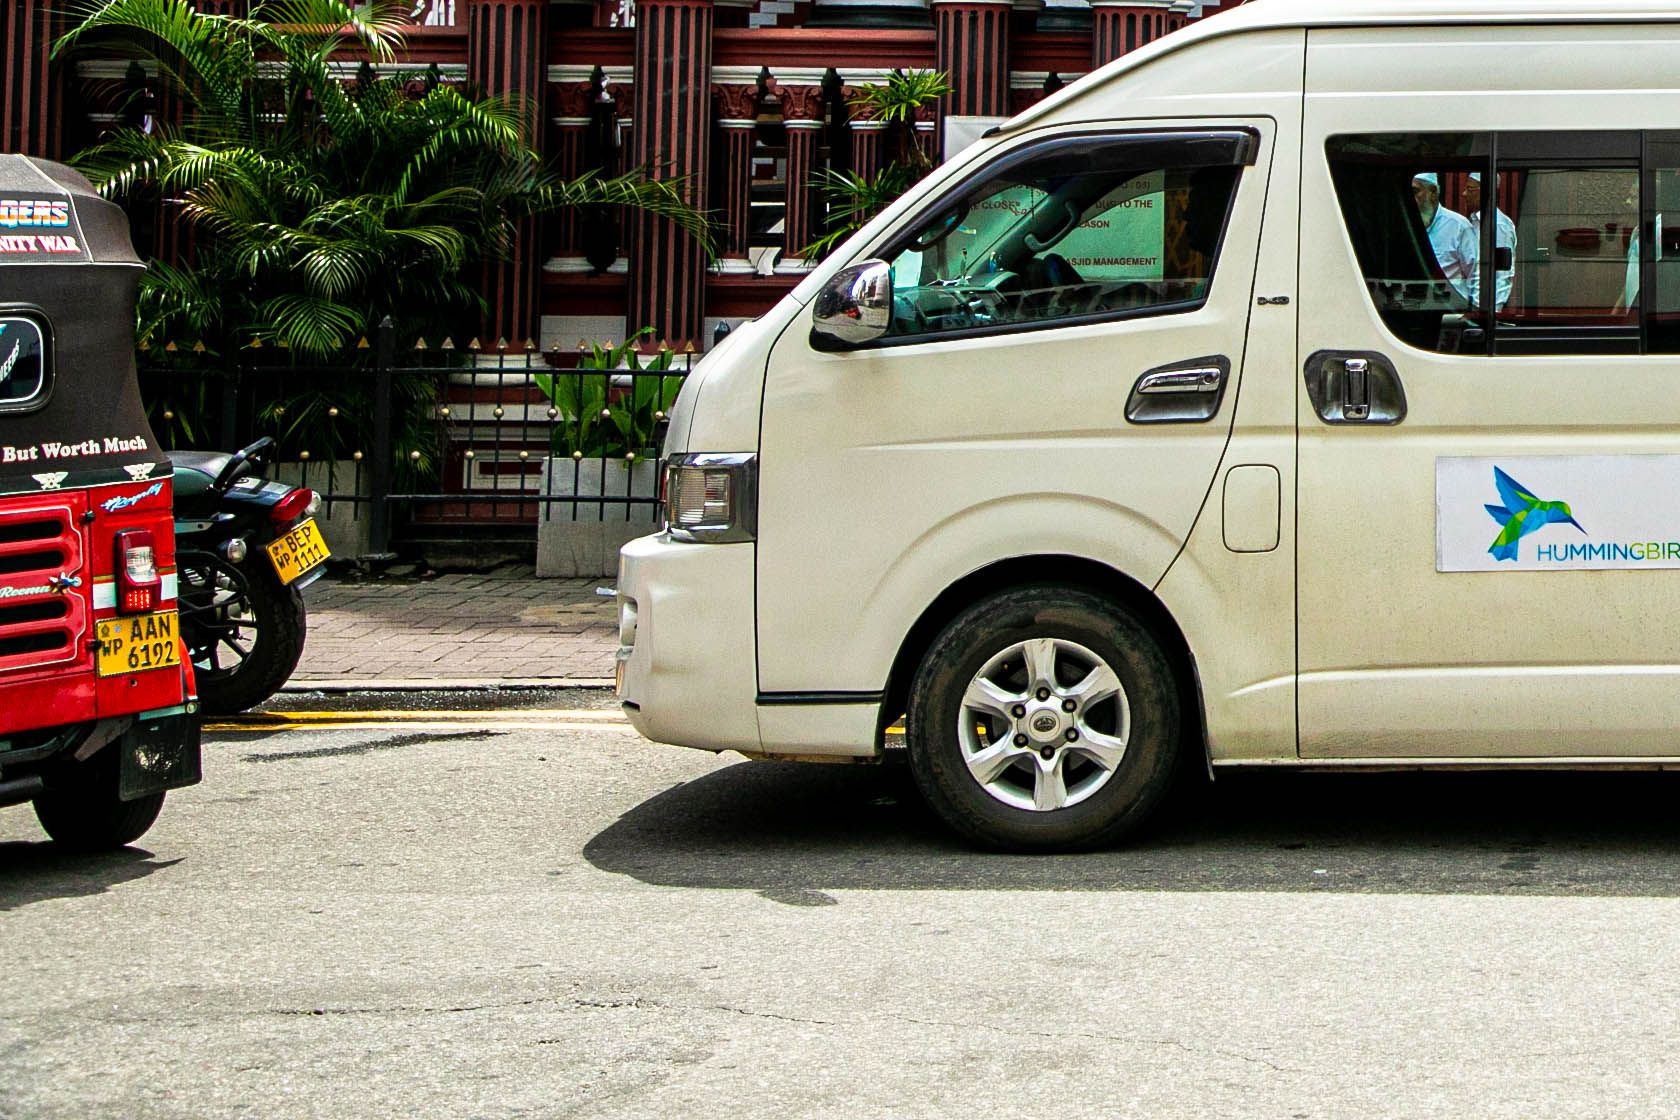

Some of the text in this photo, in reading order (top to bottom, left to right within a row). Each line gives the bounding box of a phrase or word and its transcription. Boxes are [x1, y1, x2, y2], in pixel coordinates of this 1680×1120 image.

[1134, 199, 1153, 209] THE
[37, 235, 81, 254] WAR
[1093, 257, 1157, 266] MANAGEMENT
[2, 435, 148, 463] But Worth Much
[285, 526, 311, 553] BEP
[276, 552, 290, 570] WP
[294, 543, 324, 572] 1111
[130, 614, 171, 643] AAN
[101, 638, 123, 656] WP
[128, 641, 174, 669] 6192
